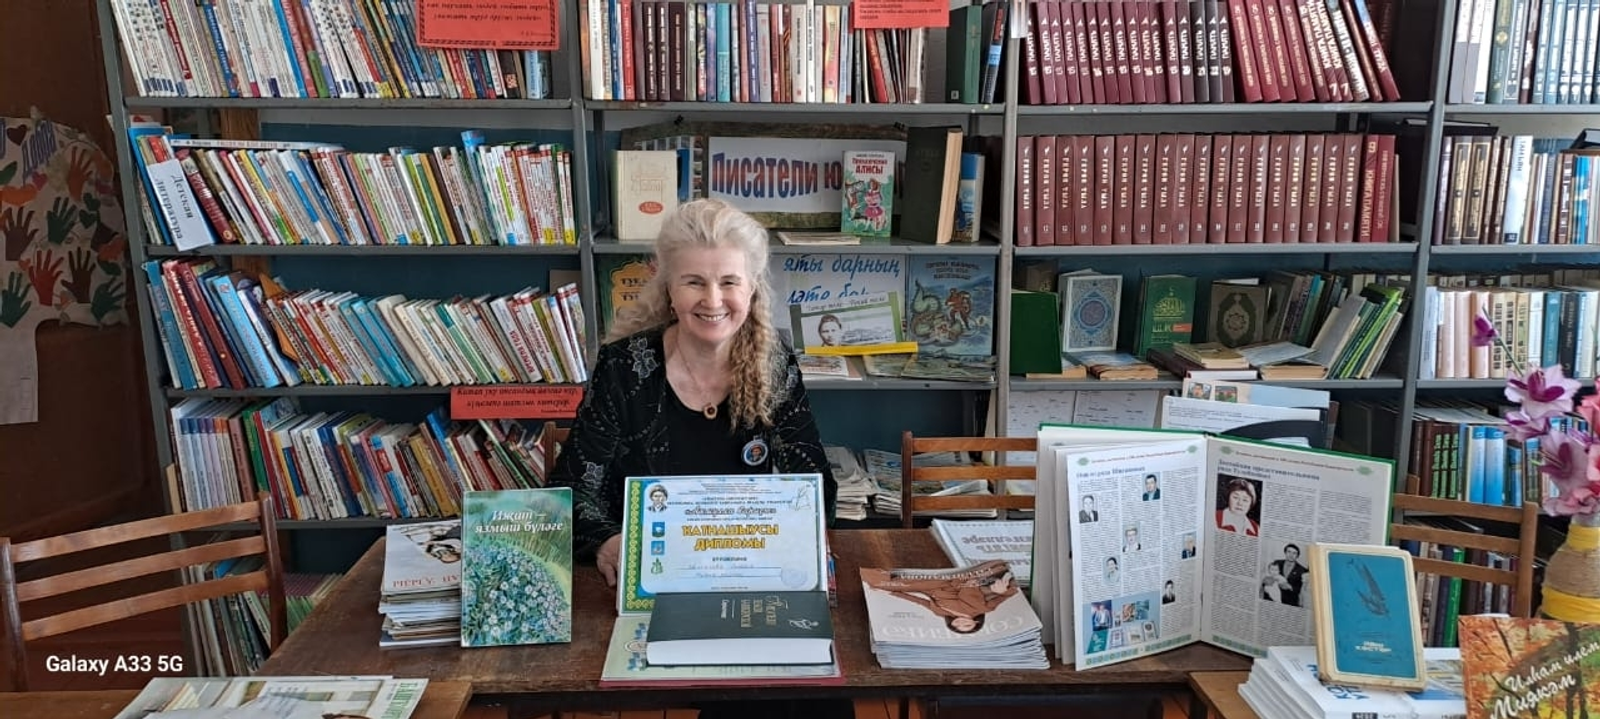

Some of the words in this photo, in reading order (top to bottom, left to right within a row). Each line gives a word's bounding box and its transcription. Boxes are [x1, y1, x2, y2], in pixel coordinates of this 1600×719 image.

[712, 152, 818, 198] Писатели
[856, 165, 883, 174] АЛИСЫ
[171, 175, 193, 219] Детская
[474, 523, 521, 535] язмыш
[694, 537, 765, 551] ДИПЛОМЫ
[1504, 662, 1562, 692] Илһам
[1563, 642, 1600, 665] илем
[1490, 675, 1576, 719] Миякәм
